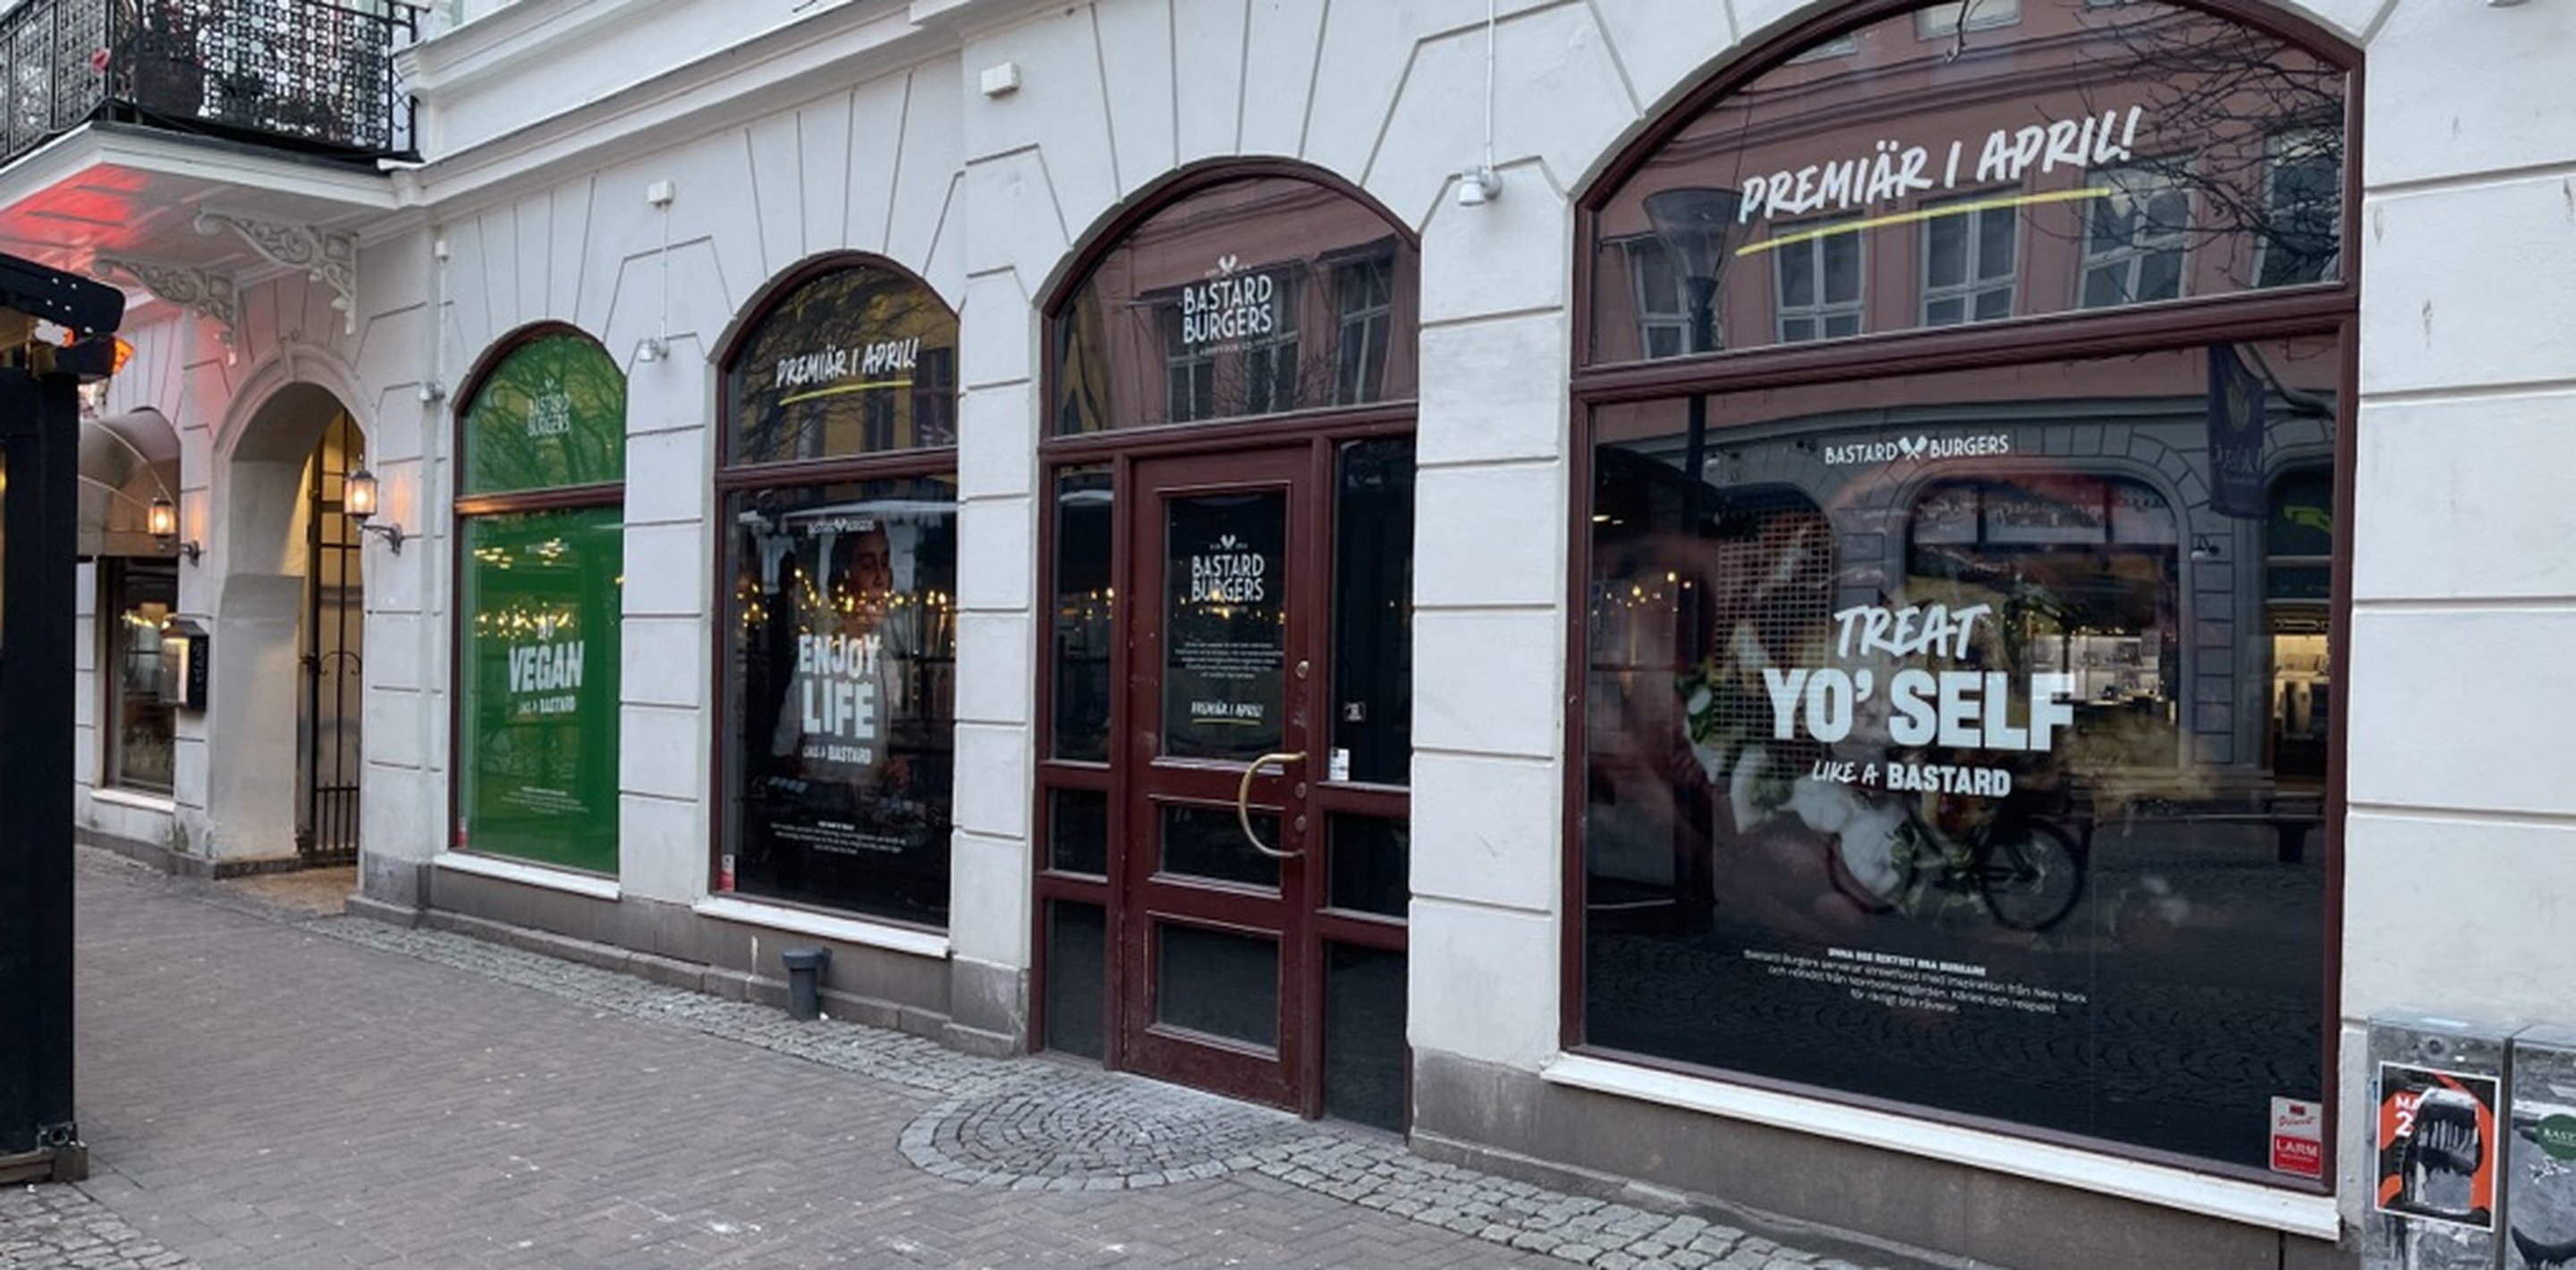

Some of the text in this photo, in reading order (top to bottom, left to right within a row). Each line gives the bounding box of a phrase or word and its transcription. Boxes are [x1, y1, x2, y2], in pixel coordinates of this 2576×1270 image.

[1738, 105, 2142, 224] PREMIÄR I APRIL!
[1183, 275, 1272, 315] BASTARD
[1183, 305, 1272, 343] BURGERS
[775, 337, 919, 388] PREMIÄR I APRIL!
[1825, 435, 2009, 465] BASTARD BURGERS
[1191, 553, 1265, 579] BASTARD
[1191, 577, 1265, 604] BURGERS
[1835, 604, 1991, 659] TREAT
[509, 640, 584, 692] VEGAN
[799, 633, 880, 678] ENJOY
[802, 678, 875, 739] LIFE
[1888, 669, 2076, 751] SELF
[827, 744, 872, 765] BASTARD
[1811, 760, 2012, 798] LIKE A BASTARD
[1767, 964, 1786, 976] och
[1826, 970, 1847, 984] från
[1987, 995, 2010, 1007] och
[1784, 953, 1819, 969] Burgers
[1947, 975, 2005, 993] inspiration
[2008, 983, 2031, 996] från
[2033, 987, 2058, 999] New
[2061, 991, 2089, 1003] York
[2275, 1138, 2319, 1158] LARM
